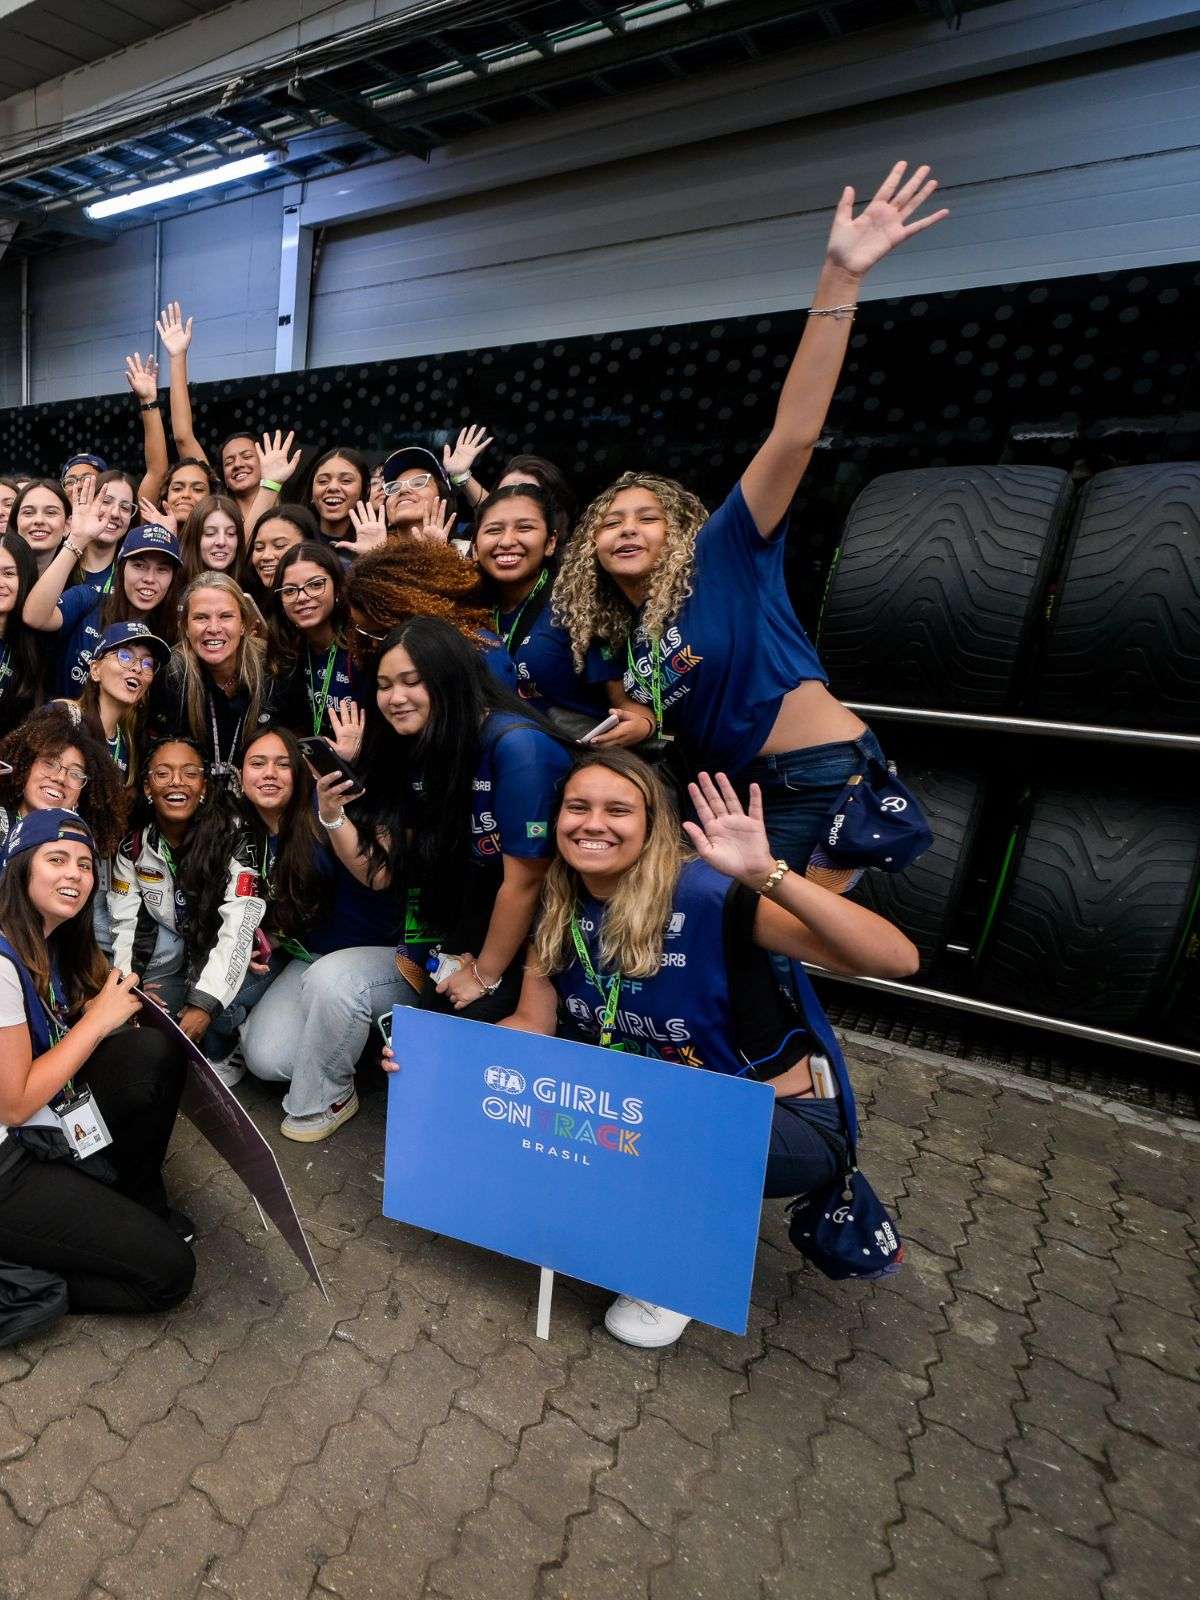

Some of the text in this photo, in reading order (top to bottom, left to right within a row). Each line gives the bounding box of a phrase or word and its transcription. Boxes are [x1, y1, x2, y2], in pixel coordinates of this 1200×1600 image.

[828, 821, 844, 846] Porto
[484, 1066, 644, 1125] FIA GIRLS
[482, 1096, 642, 1157] ON TRACK
[522, 1138, 591, 1166] BRASIL
